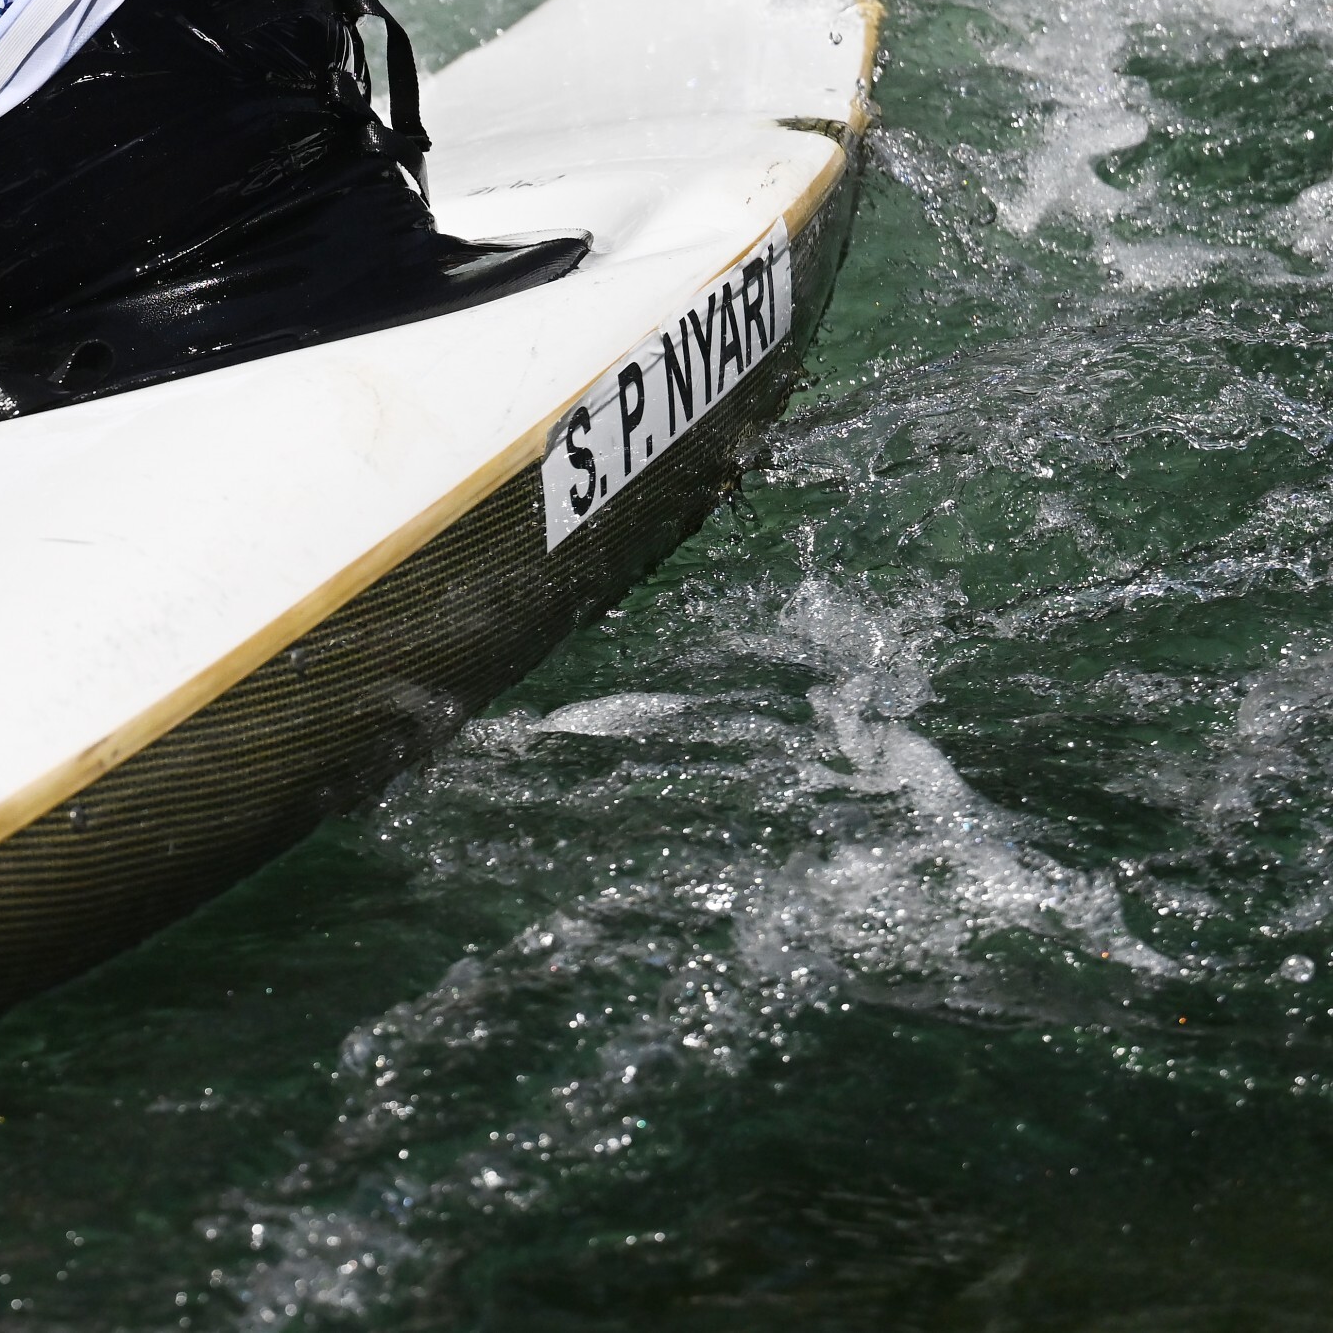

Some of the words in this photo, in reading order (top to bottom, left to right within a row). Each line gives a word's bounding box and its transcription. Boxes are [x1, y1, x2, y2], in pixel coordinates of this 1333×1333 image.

[565, 405, 608, 517] S.
[617, 361, 654, 477] P.
[661, 242, 776, 438] NYARI
